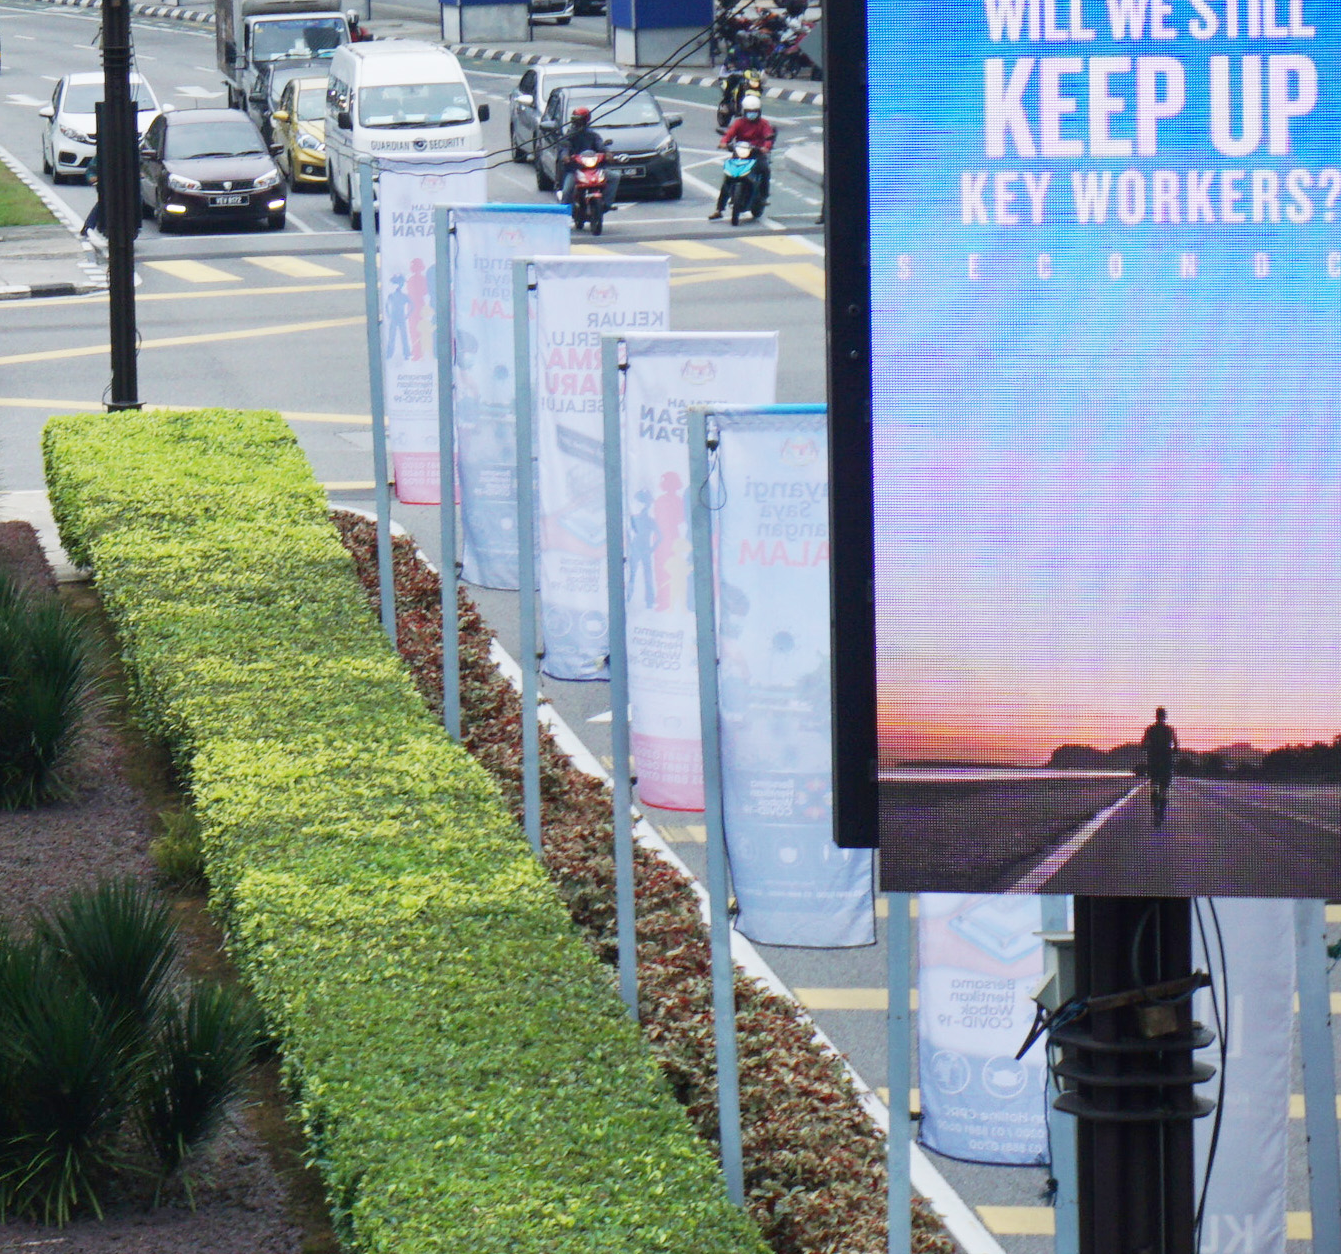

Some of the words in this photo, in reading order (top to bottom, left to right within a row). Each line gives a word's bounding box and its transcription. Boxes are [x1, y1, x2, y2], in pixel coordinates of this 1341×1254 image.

[983, 55, 1187, 158] KEEP
[1210, 54, 1318, 157] UP
[371, 140, 410, 151] GUARDIAN
[429, 136, 466, 150] SECURITY
[960, 170, 1054, 225] KEY
[1071, 167, 1341, 225] WORKERS?
